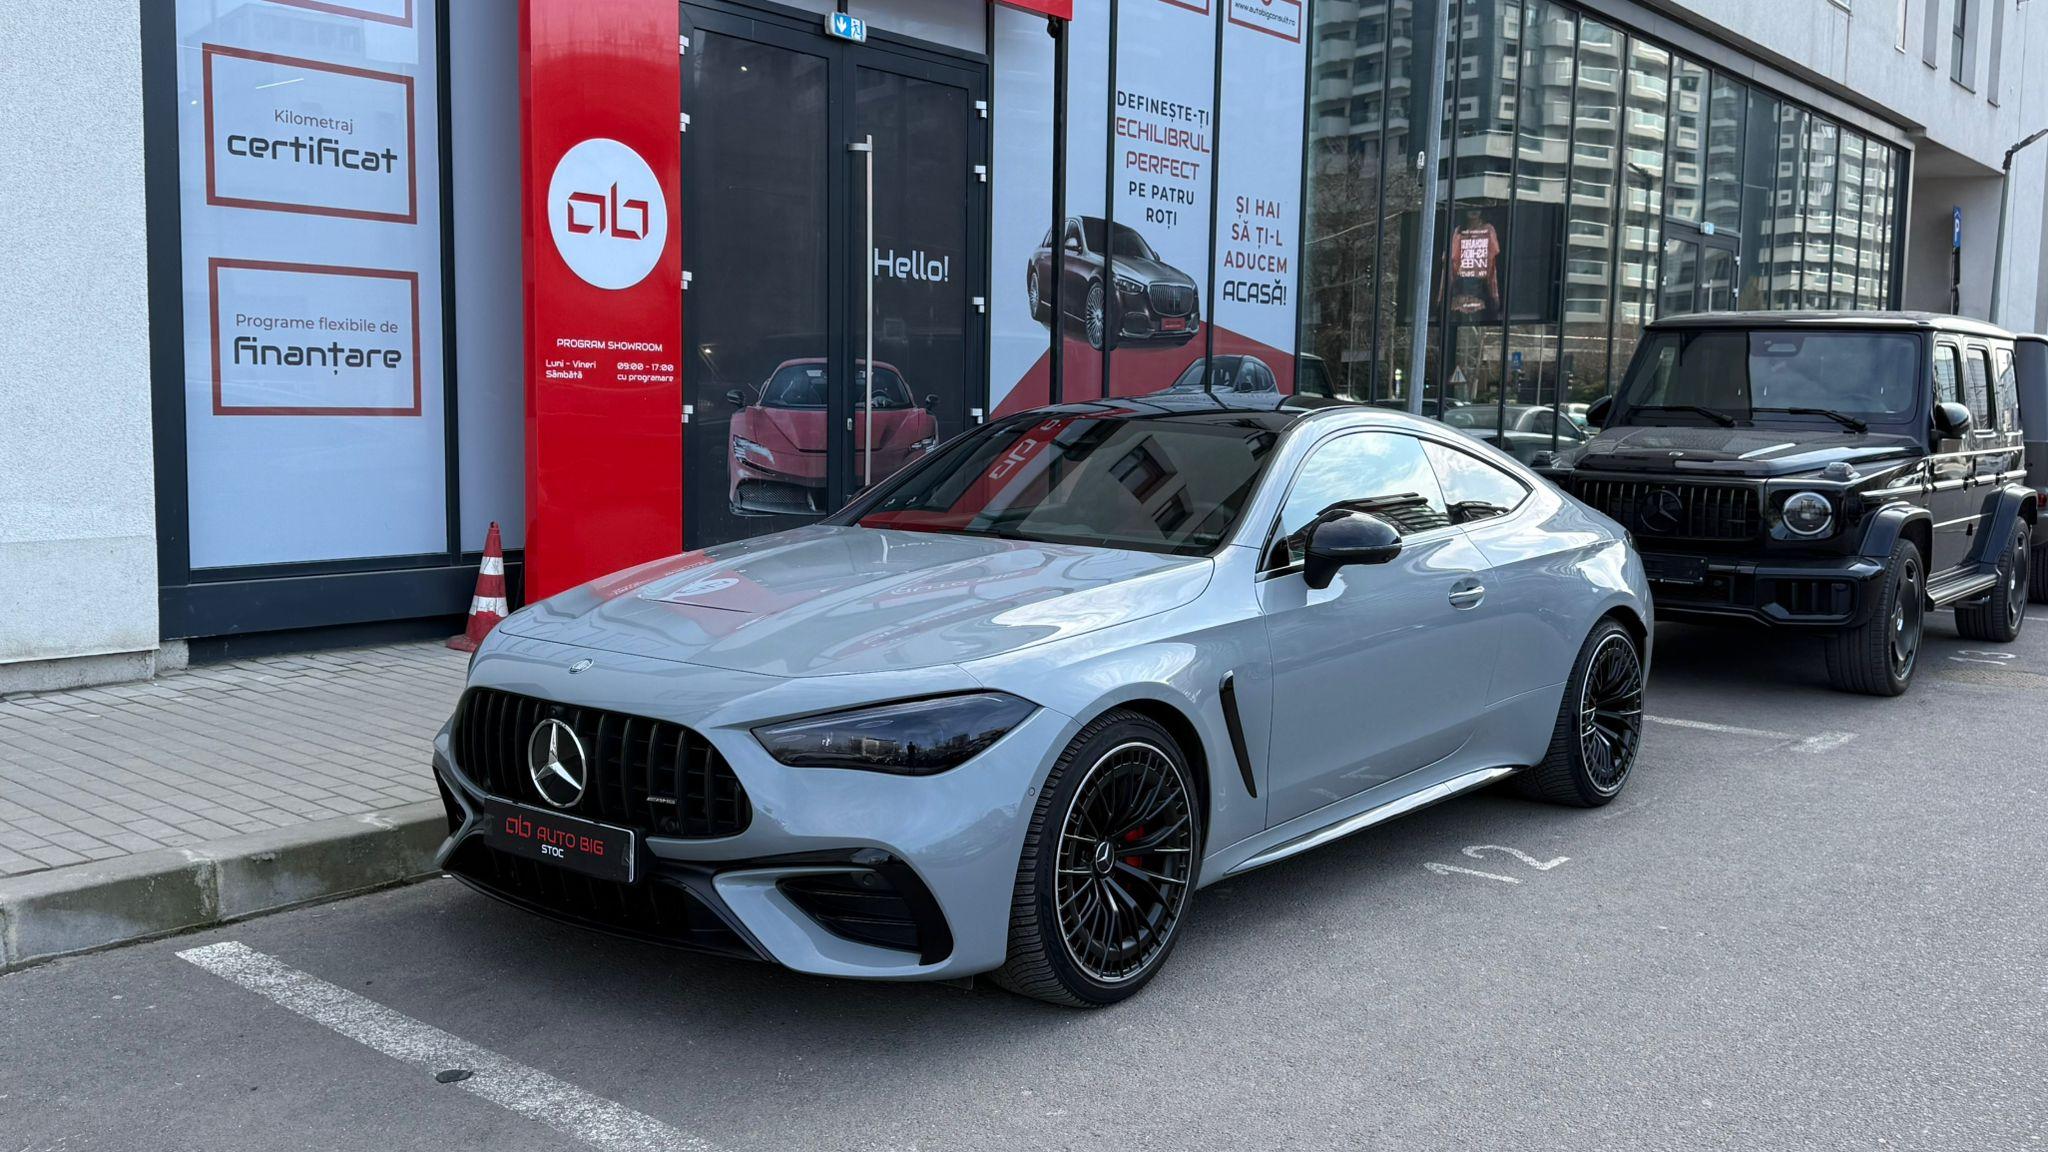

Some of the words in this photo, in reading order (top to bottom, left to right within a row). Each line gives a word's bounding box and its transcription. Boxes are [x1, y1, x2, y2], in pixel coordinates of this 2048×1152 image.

[274, 109, 354, 135] Kilometraj
[1117, 90, 1209, 128] DEFINEȘTE-ȚI
[1116, 117, 1210, 154] ECHILIBRUL
[227, 134, 398, 174] certificat
[1126, 151, 1199, 181] PERFECT
[1129, 181, 1146, 198] PE
[1151, 184, 1194, 206] PATRU
[1146, 207, 1177, 229] ROȚI
[1236, 195, 1249, 220] ȘI
[1255, 199, 1280, 219] HAI
[1231, 219, 1250, 242] SĂ
[1256, 226, 1283, 250] ȚI-L
[874, 247, 949, 282] Hello!
[1224, 250, 1287, 274] ADUCEM
[1223, 278, 1287, 306] ACASĂ!
[236, 313, 315, 331] Programe
[319, 316, 376, 332] flexibile
[379, 320, 398, 333] de
[233, 335, 402, 376] finanțare
[556, 338, 605, 350] PROGRAM
[608, 341, 663, 353] SHOWROOM
[545, 359, 564, 368] Luni
[573, 360, 597, 369] Vineri
[616, 362, 644, 371] 09:00
[651, 363, 675, 372] 17:00
[616, 372, 627, 381] cu
[628, 373, 674, 383] programare
[536, 826, 576, 849] AUTO
[579, 837, 605, 856] BIG
[541, 844, 565, 858] STOC
[1423, 844, 1571, 884] 12
